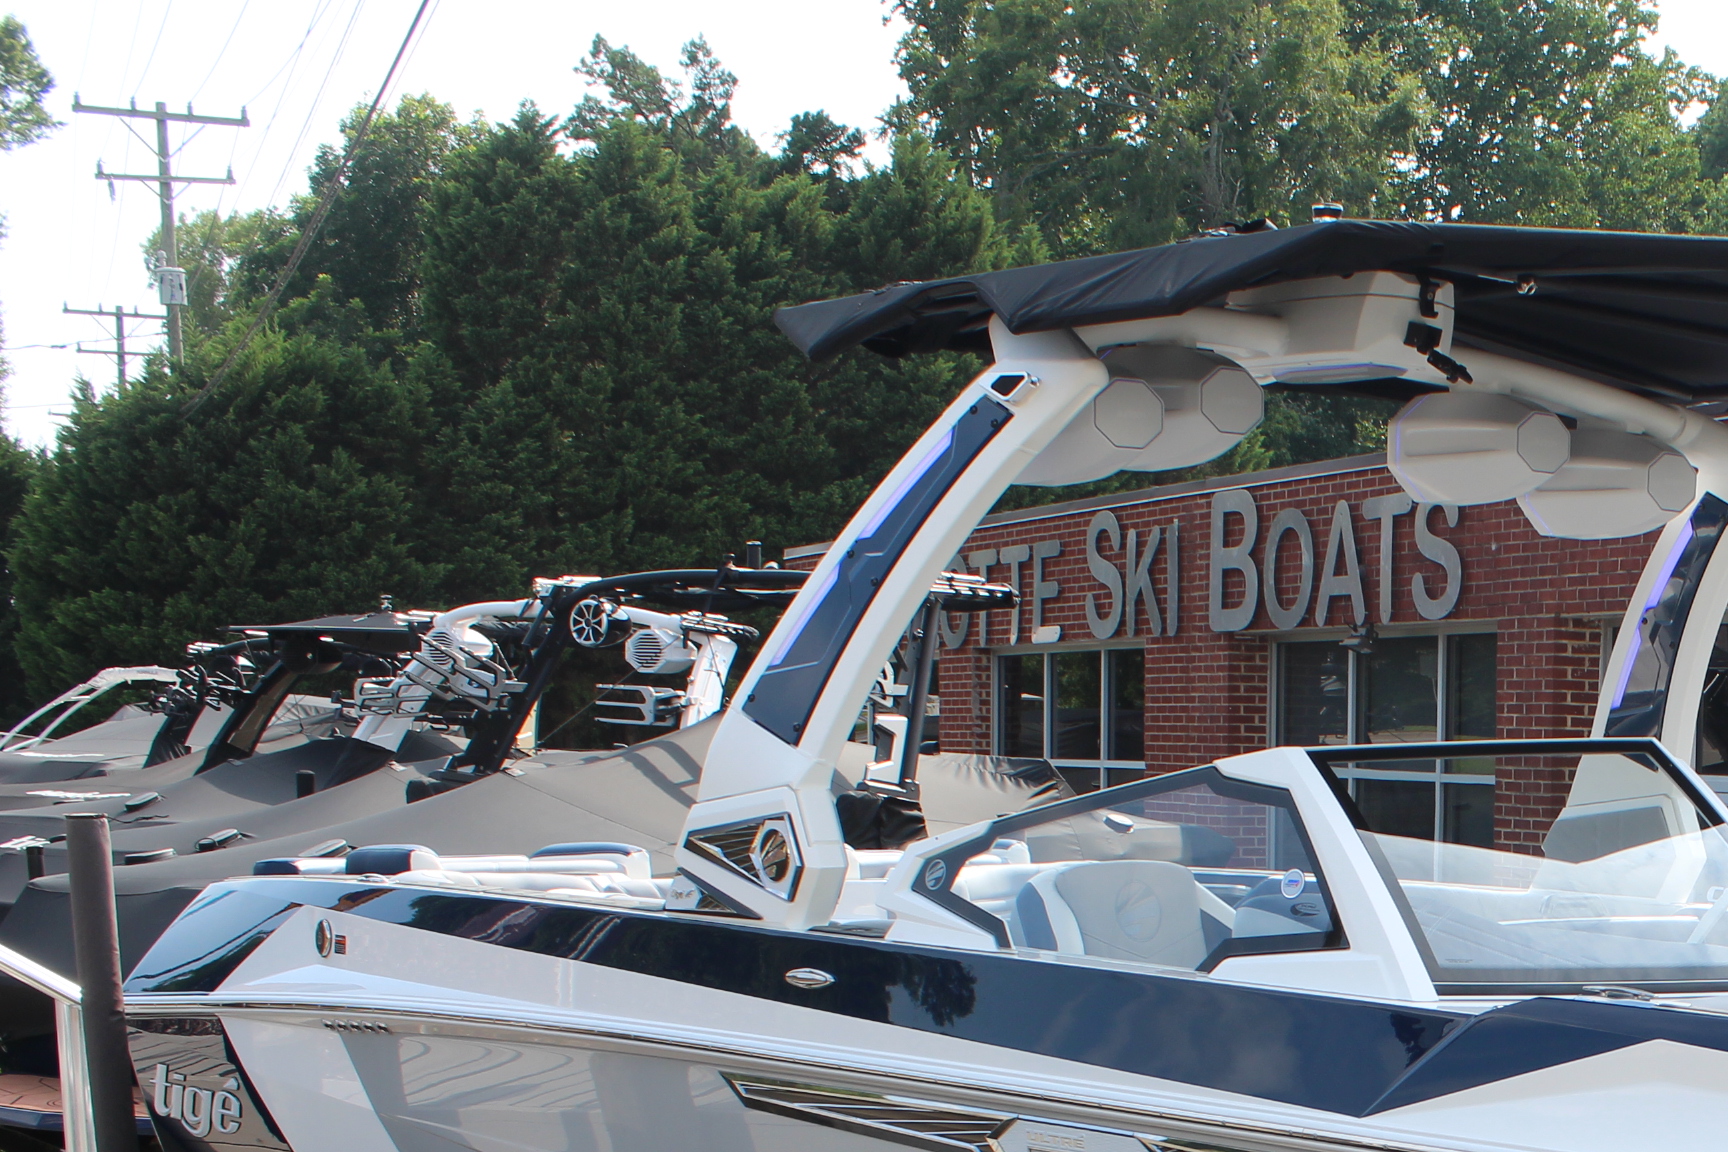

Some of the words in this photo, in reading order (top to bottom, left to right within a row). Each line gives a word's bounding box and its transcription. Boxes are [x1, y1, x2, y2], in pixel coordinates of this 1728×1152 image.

[937, 540, 1061, 649] OTTE
[1085, 510, 1179, 640] SKI
[1209, 488, 1462, 633] BOATS
